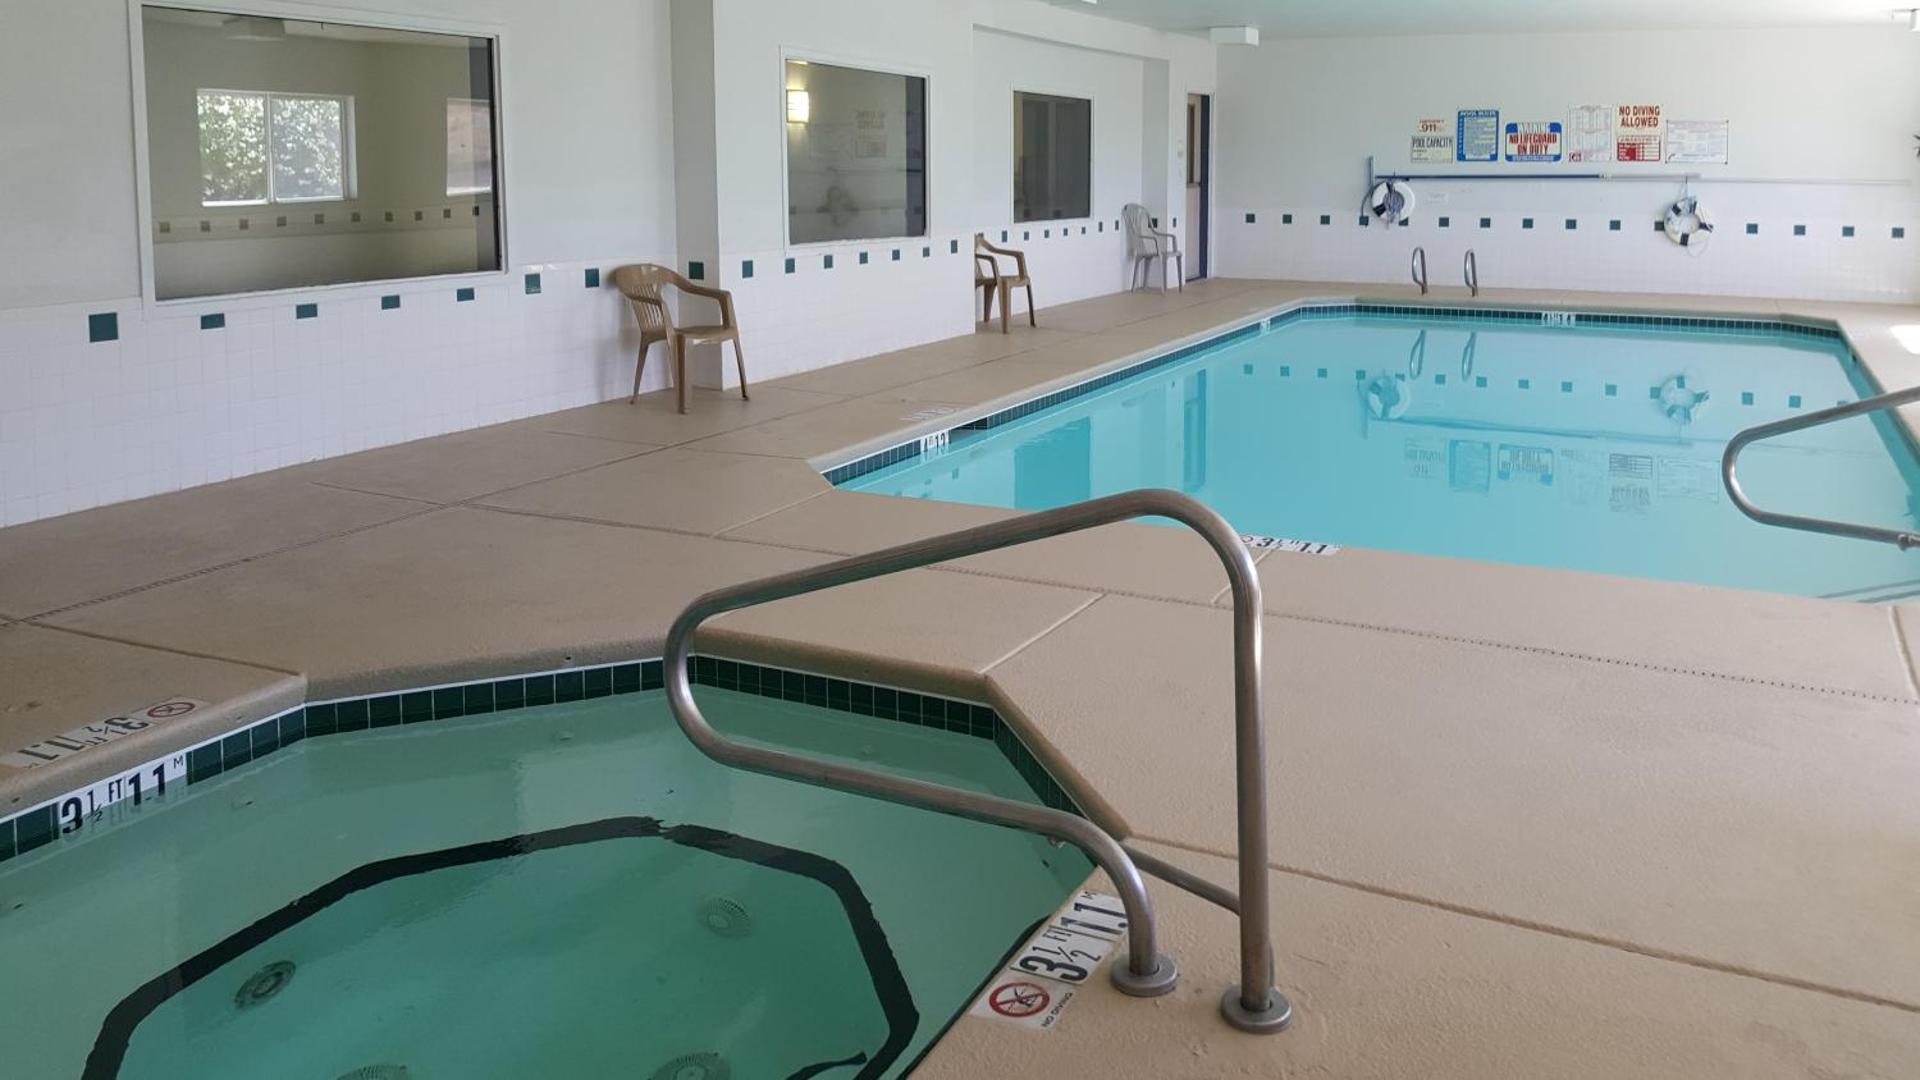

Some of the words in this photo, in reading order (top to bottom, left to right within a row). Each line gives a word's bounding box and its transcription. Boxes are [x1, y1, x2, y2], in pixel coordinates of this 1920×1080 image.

[1619, 105, 1631, 116] NO
[1633, 105, 1660, 116] DIVING
[1620, 117, 1659, 128] ALLOWED
[1427, 136, 1454, 148] CAPACITY
[1509, 133, 1519, 144] NO
[1520, 133, 1557, 144] LIFEGUARD
[1517, 144, 1528, 155] ON
[1530, 144, 1549, 155] DUTY
[108, 778, 123, 803] FT
[173, 755, 184, 769] M
[1042, 929, 1072, 942] FT
